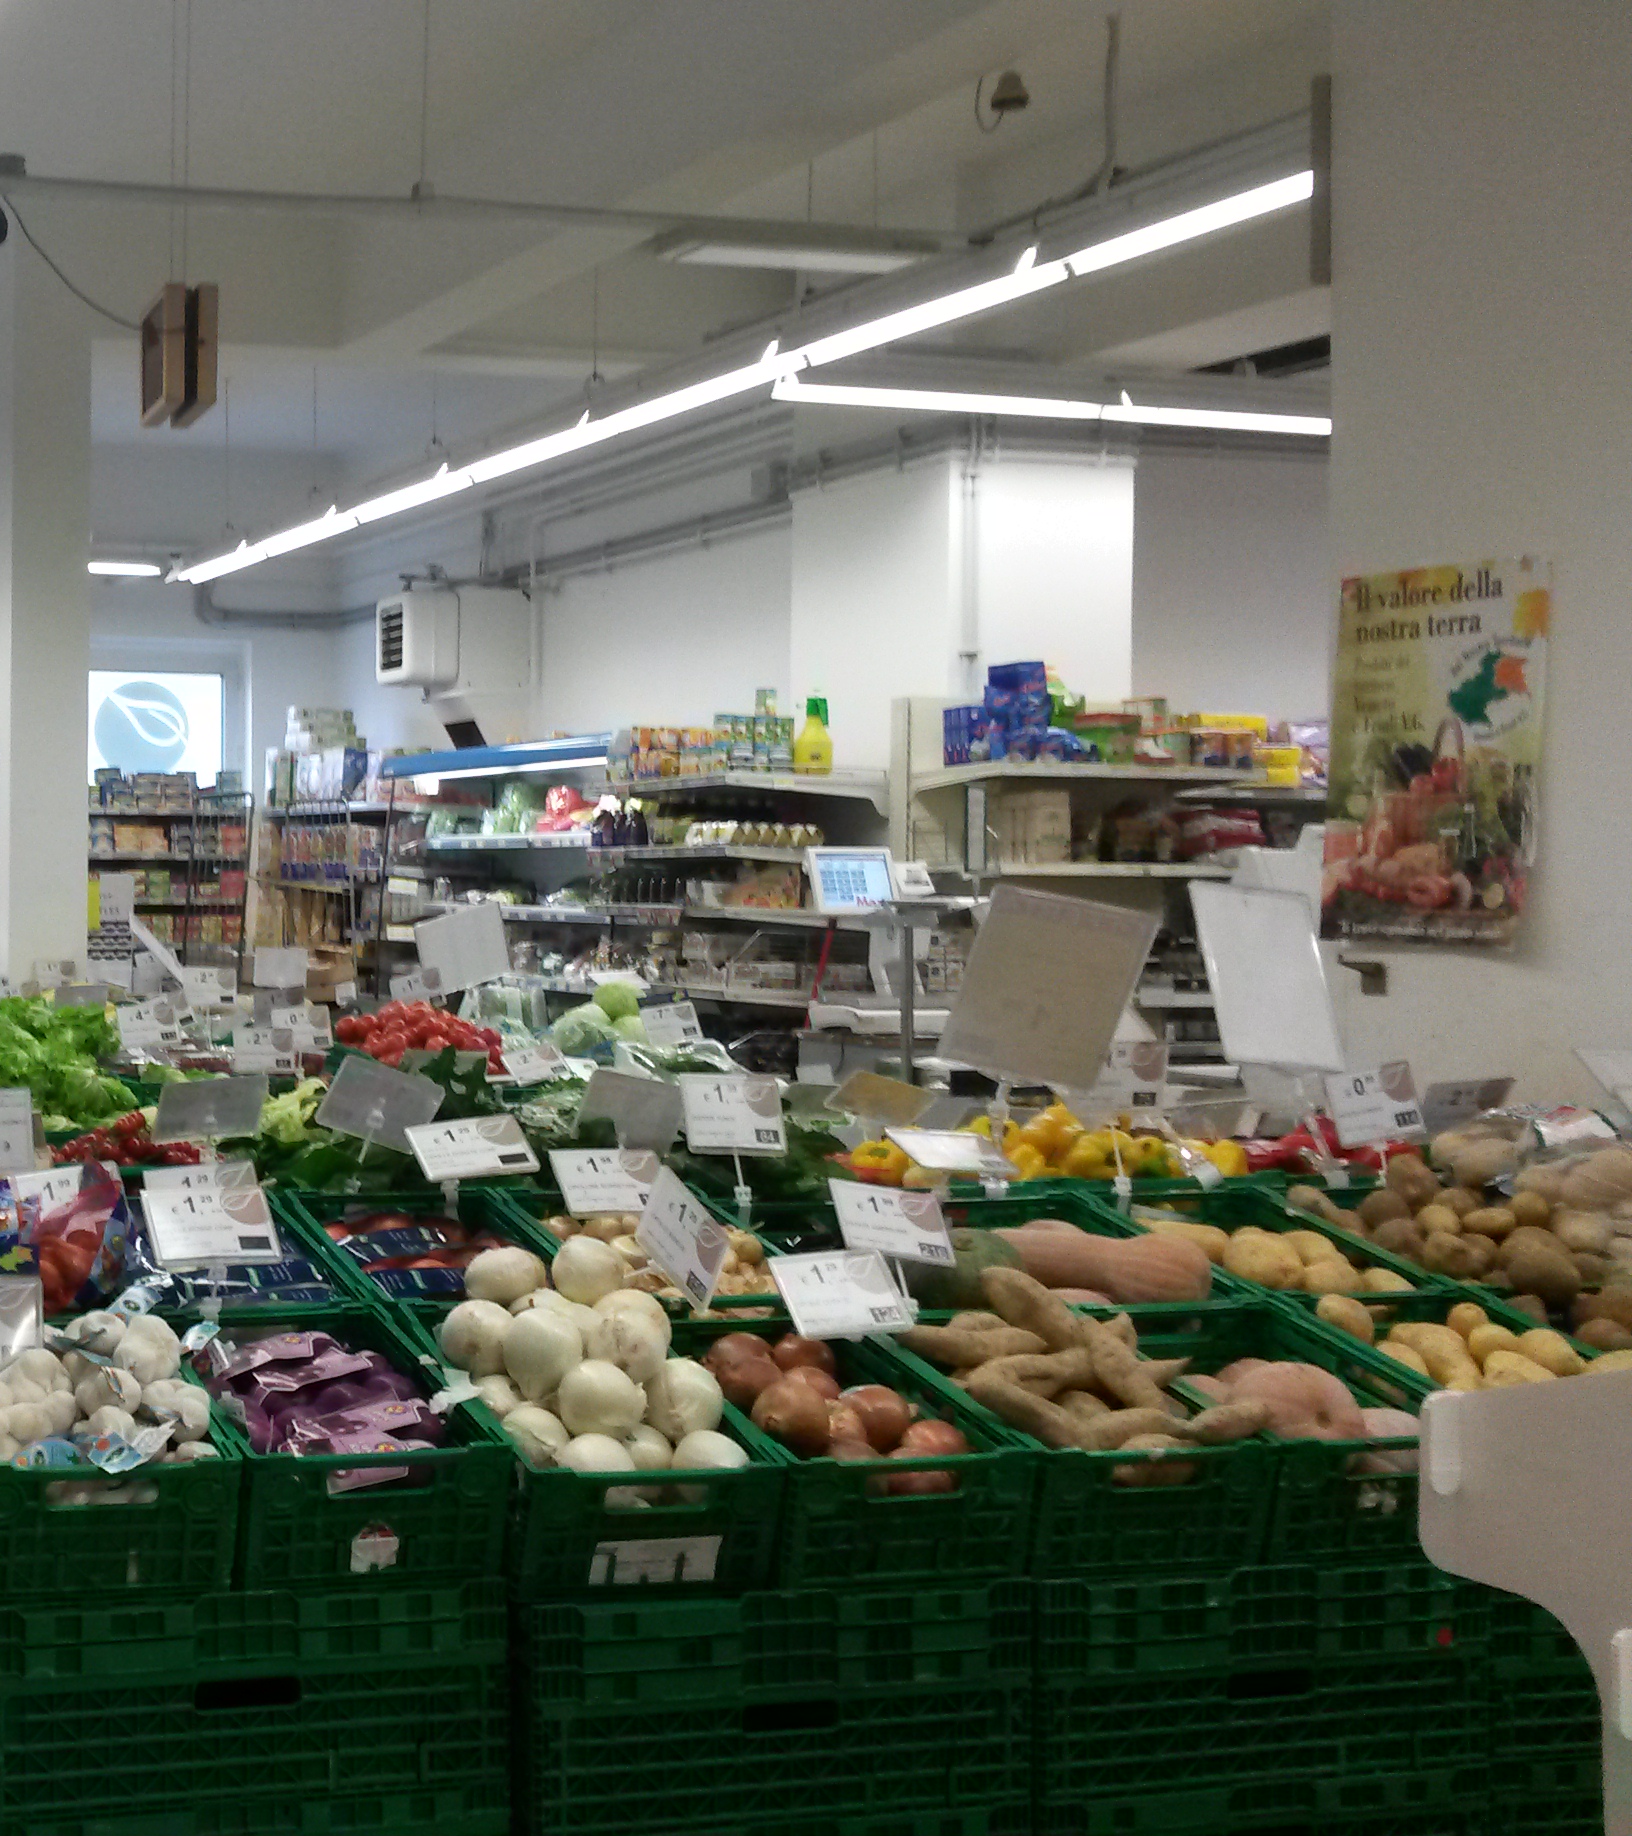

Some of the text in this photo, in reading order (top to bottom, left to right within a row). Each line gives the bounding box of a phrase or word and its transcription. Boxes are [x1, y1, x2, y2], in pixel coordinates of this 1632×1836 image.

[1355, 568, 1504, 612] Il valore della
[1355, 612, 1482, 645] nostra terra
